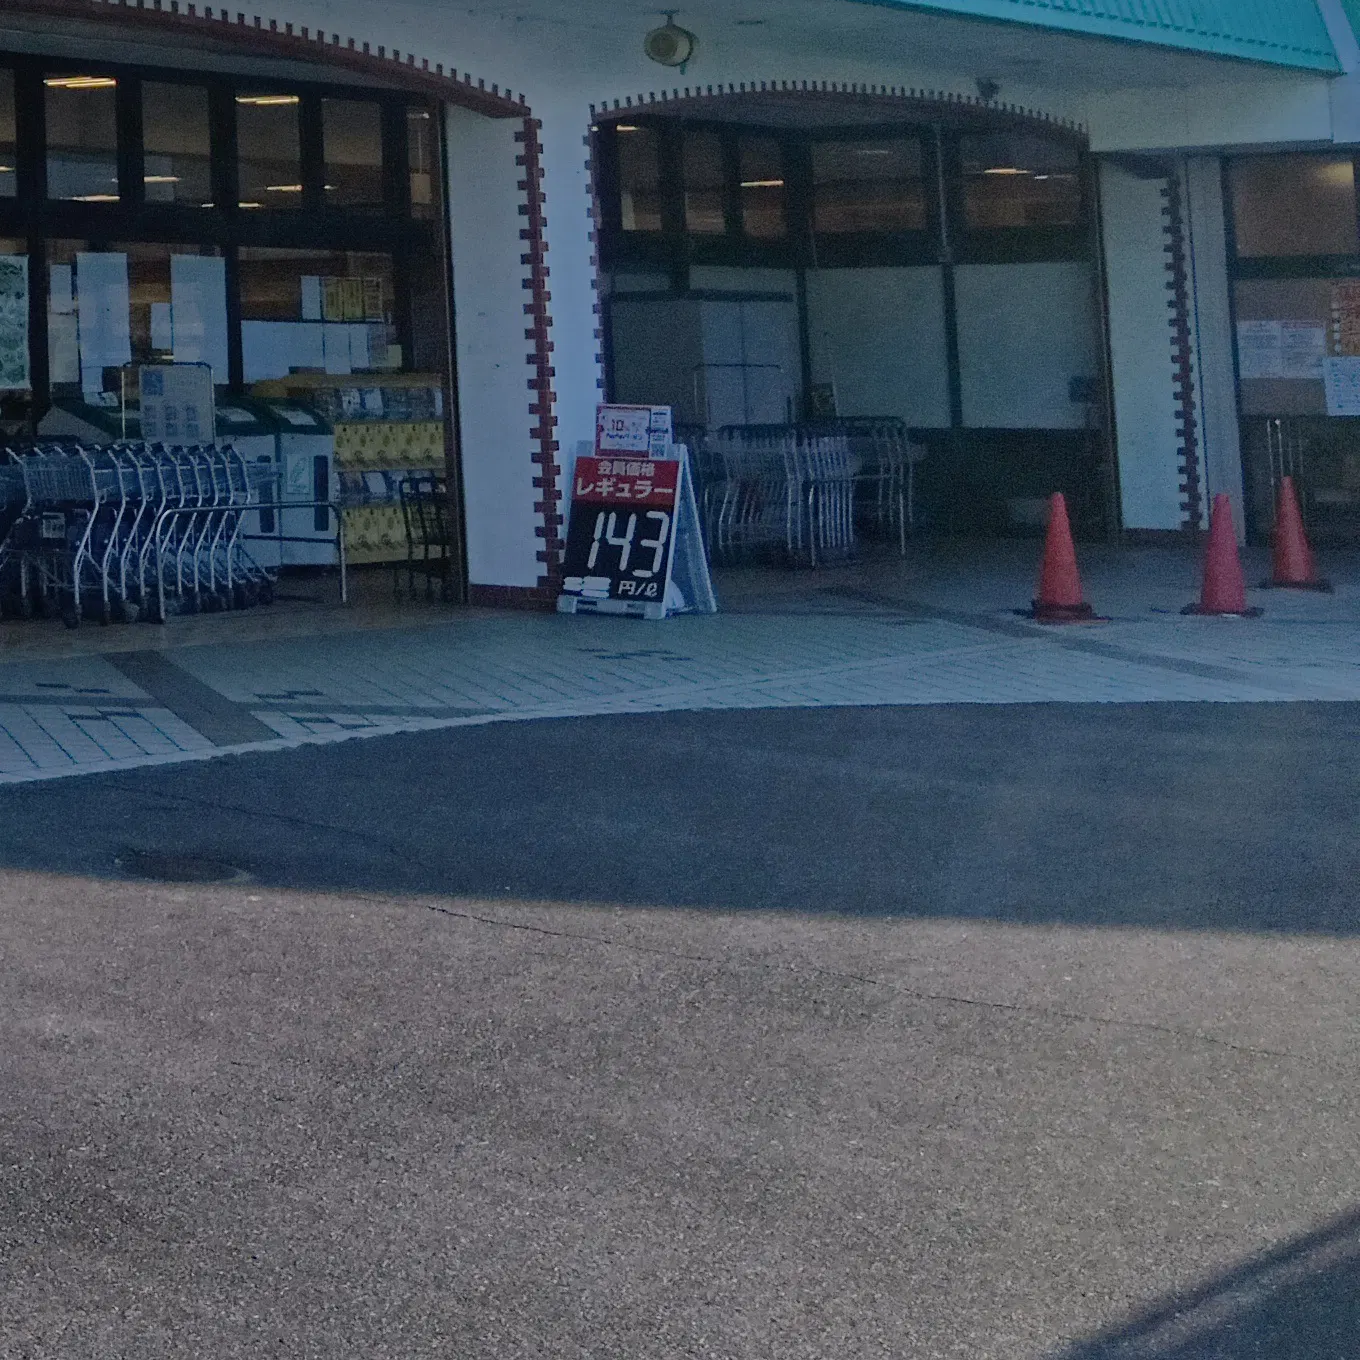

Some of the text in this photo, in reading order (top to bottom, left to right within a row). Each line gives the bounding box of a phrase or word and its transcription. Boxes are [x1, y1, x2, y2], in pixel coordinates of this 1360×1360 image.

[597, 460, 656, 477] 会員価格
[577, 477, 674, 499] レギュラー
[587, 510, 670, 578] 143
